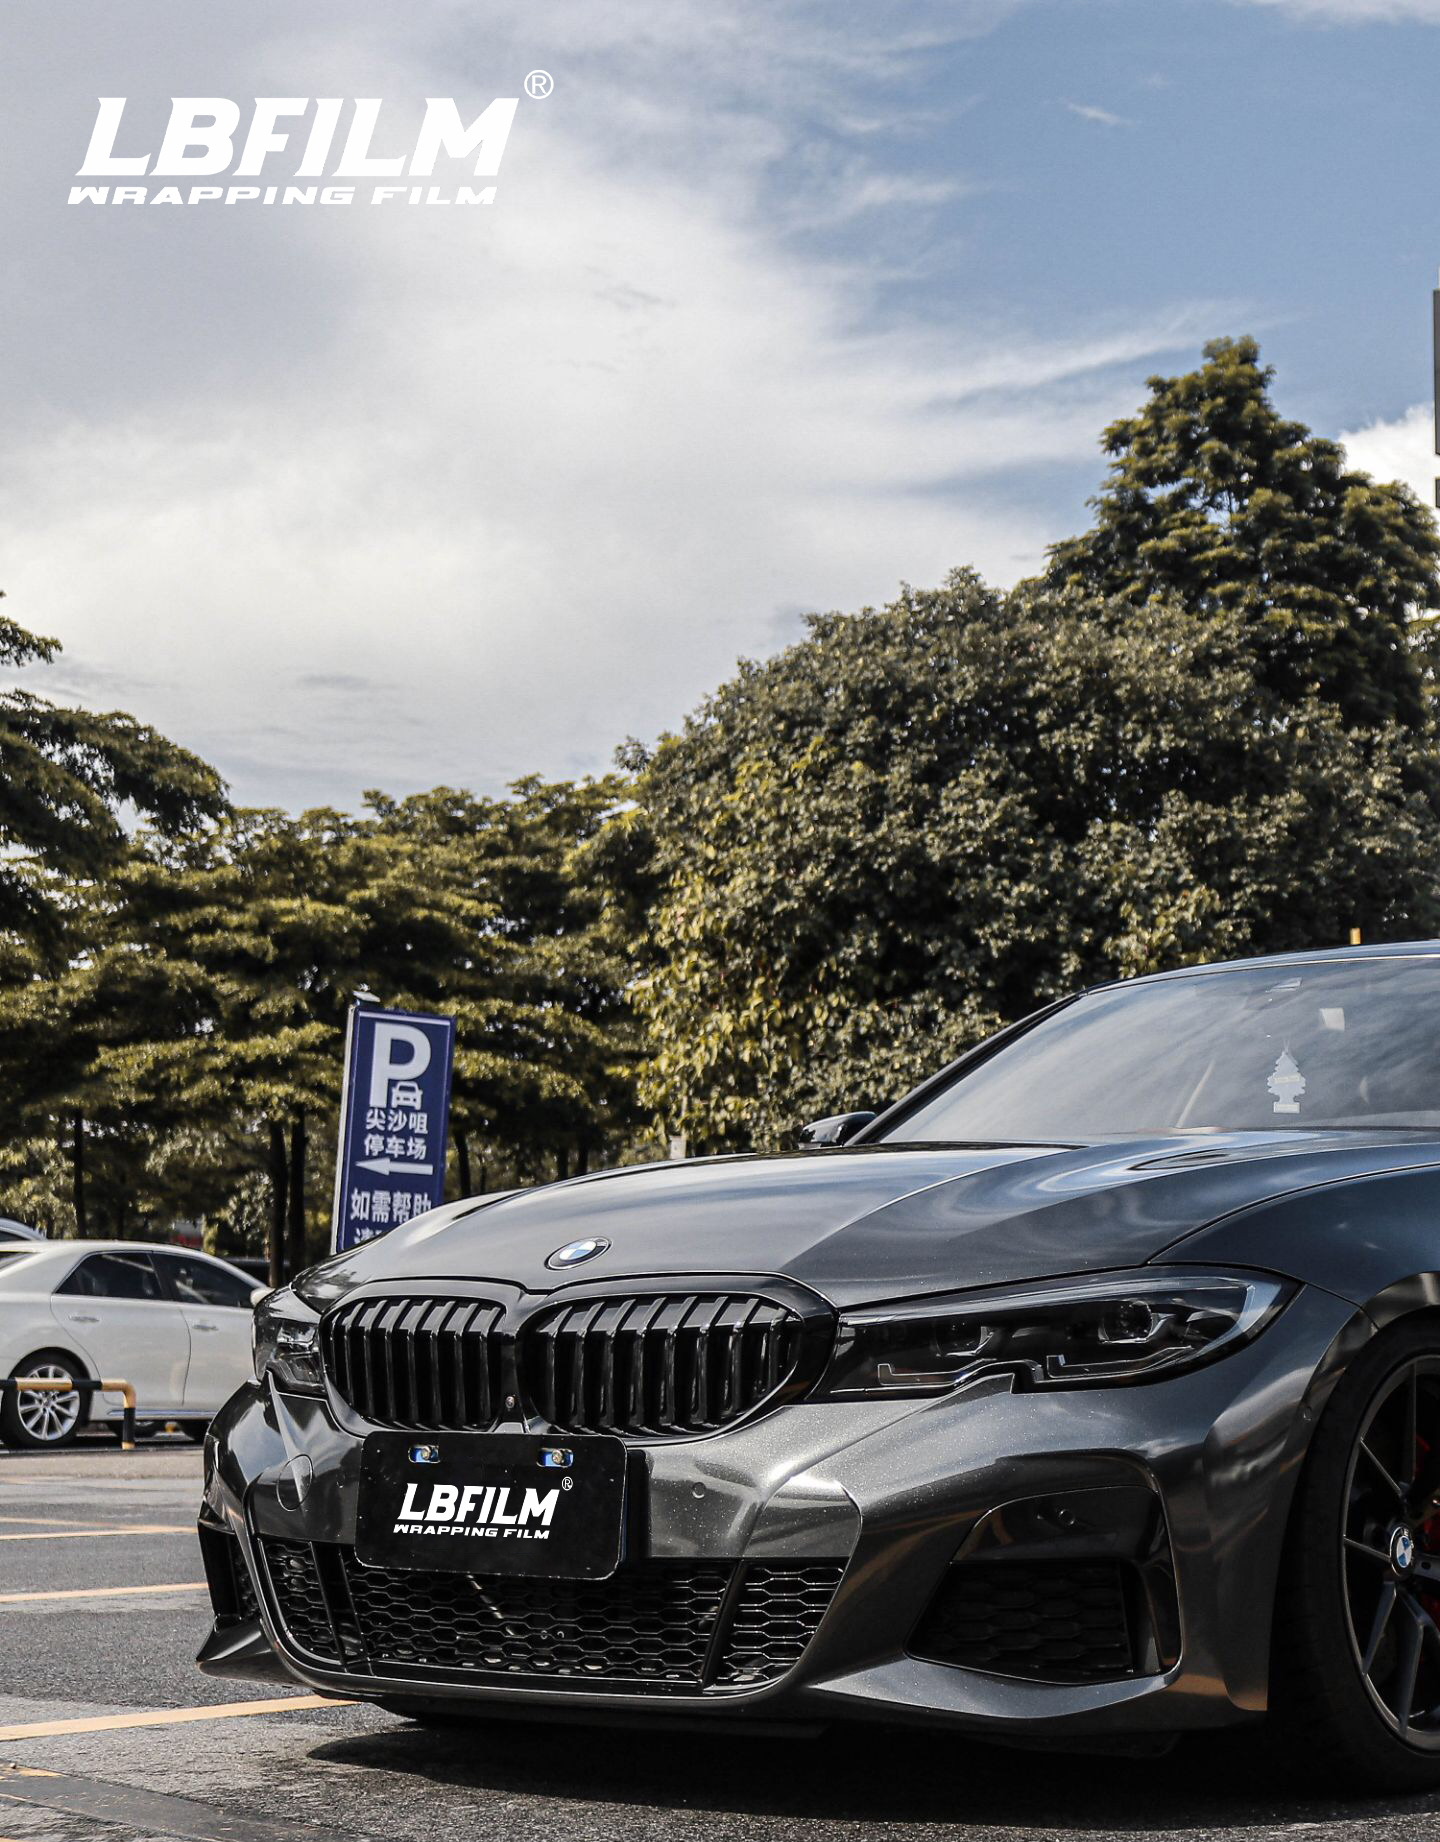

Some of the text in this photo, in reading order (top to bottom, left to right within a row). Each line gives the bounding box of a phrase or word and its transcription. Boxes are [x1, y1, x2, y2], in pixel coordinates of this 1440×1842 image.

[369, 1022, 432, 1108] P
[365, 1108, 428, 1134] 尖沙咀
[364, 1133, 427, 1160] 停车场
[350, 1187, 432, 1224] 如需帮助
[397, 1483, 560, 1526] LBFILM
[393, 1524, 550, 1540] WRAPPING FILM
